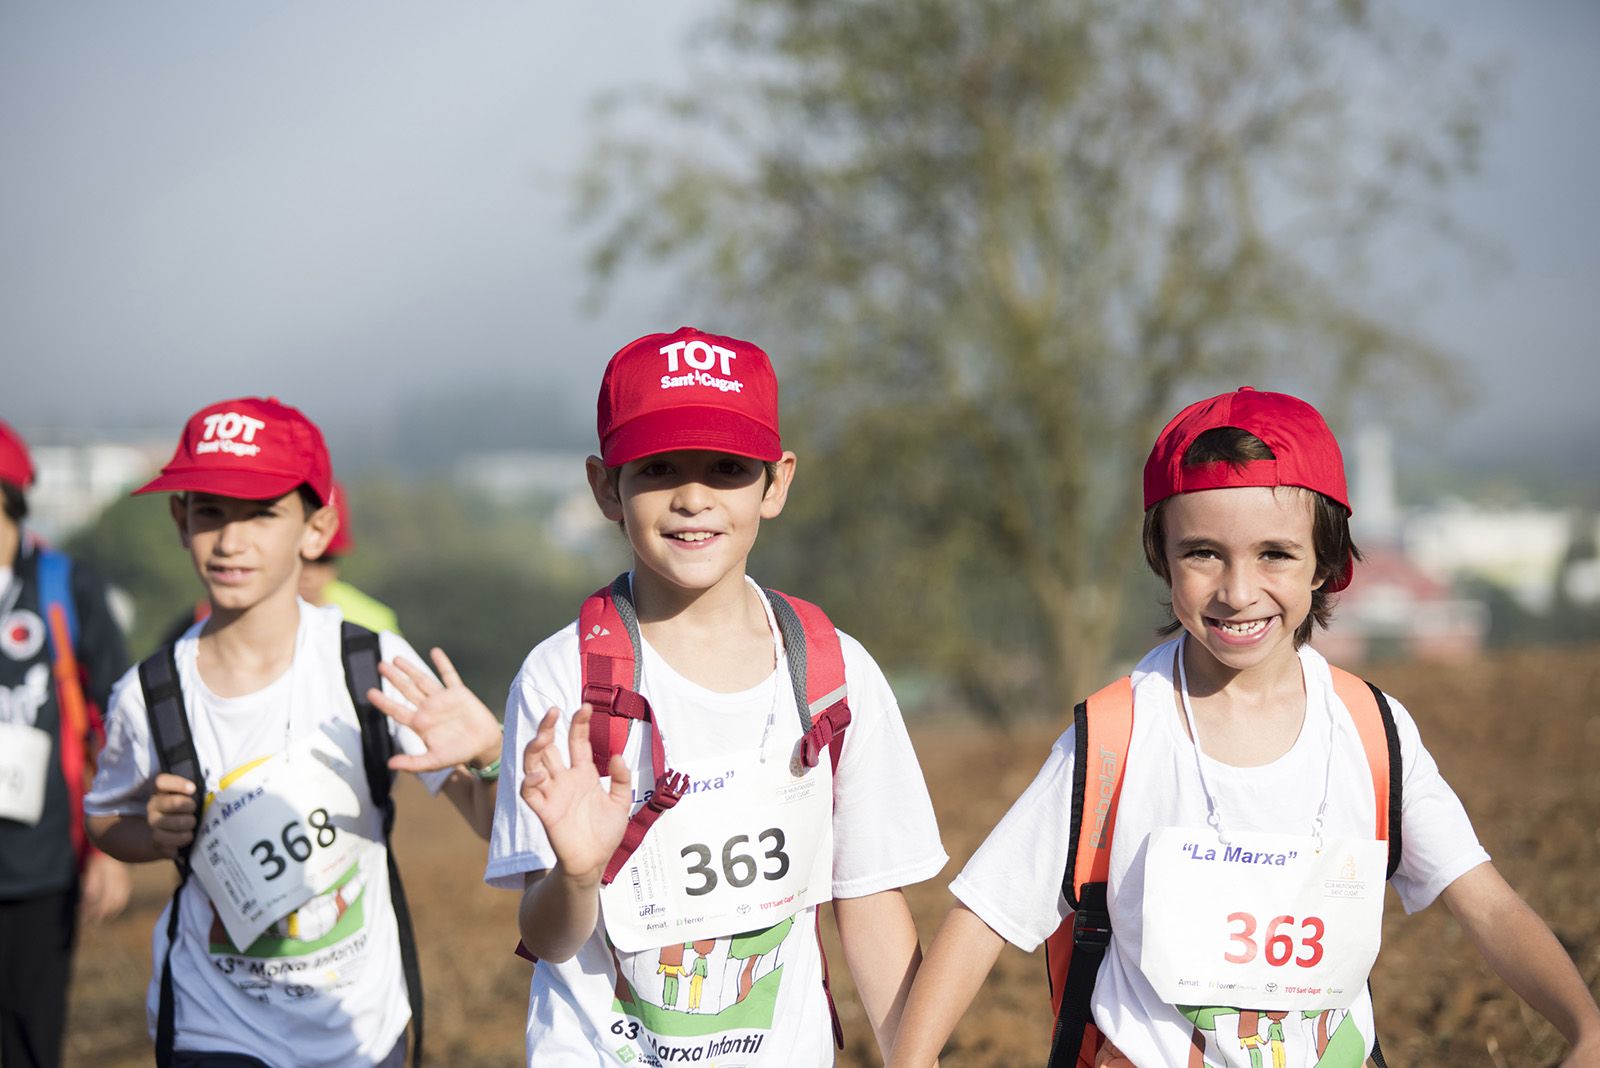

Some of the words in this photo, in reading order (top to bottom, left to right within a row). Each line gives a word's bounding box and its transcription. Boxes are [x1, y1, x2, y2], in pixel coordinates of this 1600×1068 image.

[659, 340, 737, 376] TOT
[660, 372, 695, 389] Sant
[701, 373, 743, 393] Cugat
[203, 412, 265, 443] TOT
[251, 808, 336, 882] 368
[1182, 843, 1216, 861] “La
[1223, 846, 1298, 866] Marxa”
[680, 827, 790, 897] 363
[1224, 911, 1325, 968] 363
[706, 1034, 764, 1060] Infantil
